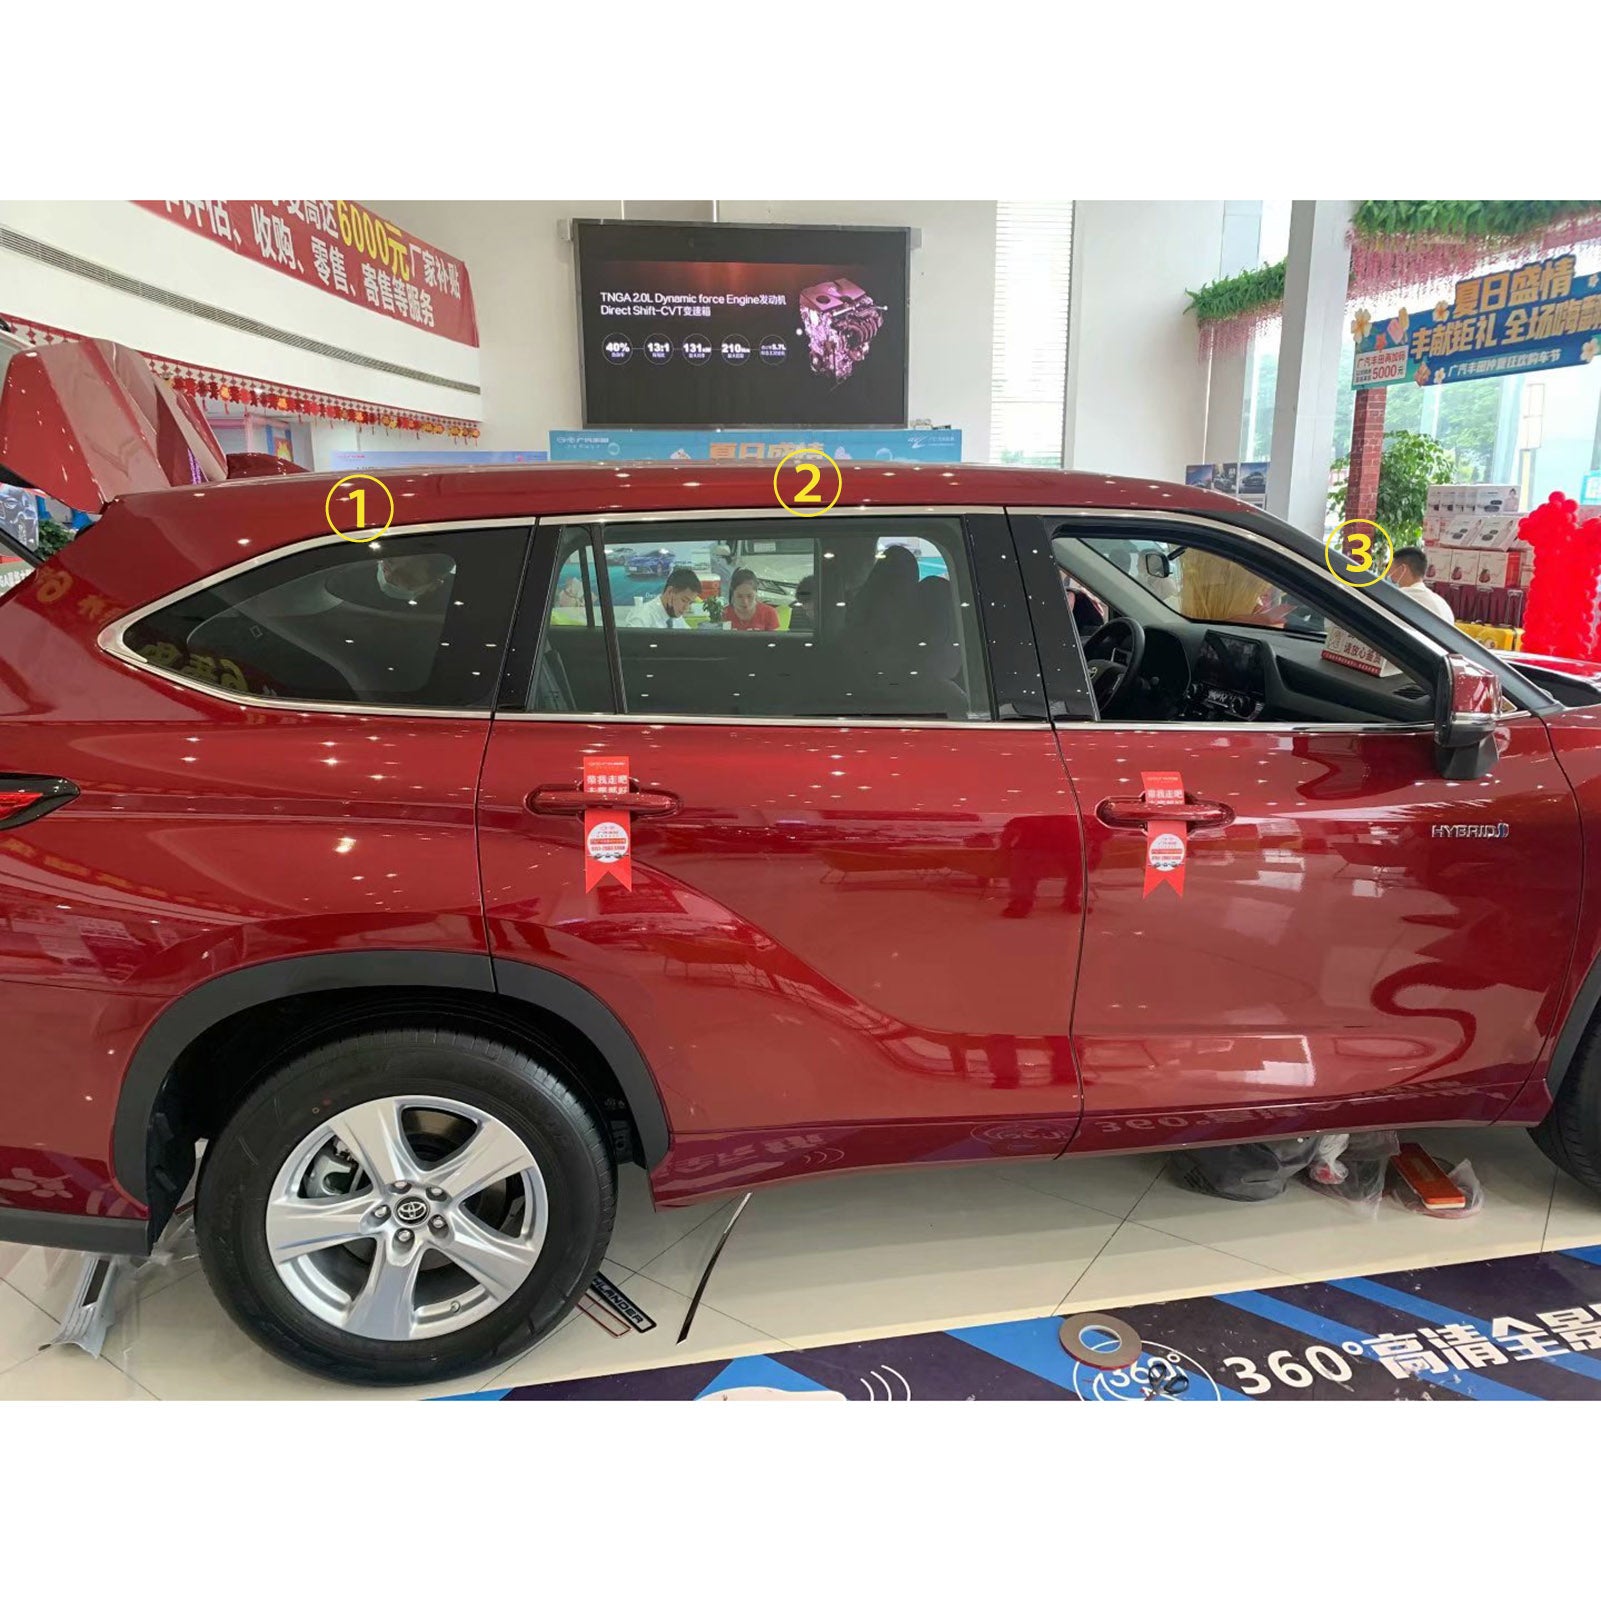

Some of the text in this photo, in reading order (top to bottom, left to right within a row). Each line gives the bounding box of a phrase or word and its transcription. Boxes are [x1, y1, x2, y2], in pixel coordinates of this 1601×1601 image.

[1453, 257, 1575, 319] 夏日盛情
[600, 292, 632, 303] TNGA
[655, 293, 697, 305] Dynamic
[698, 294, 725, 304] force
[601, 305, 632, 316] Direct
[605, 342, 630, 353] 40%
[647, 342, 671, 353] 13:1
